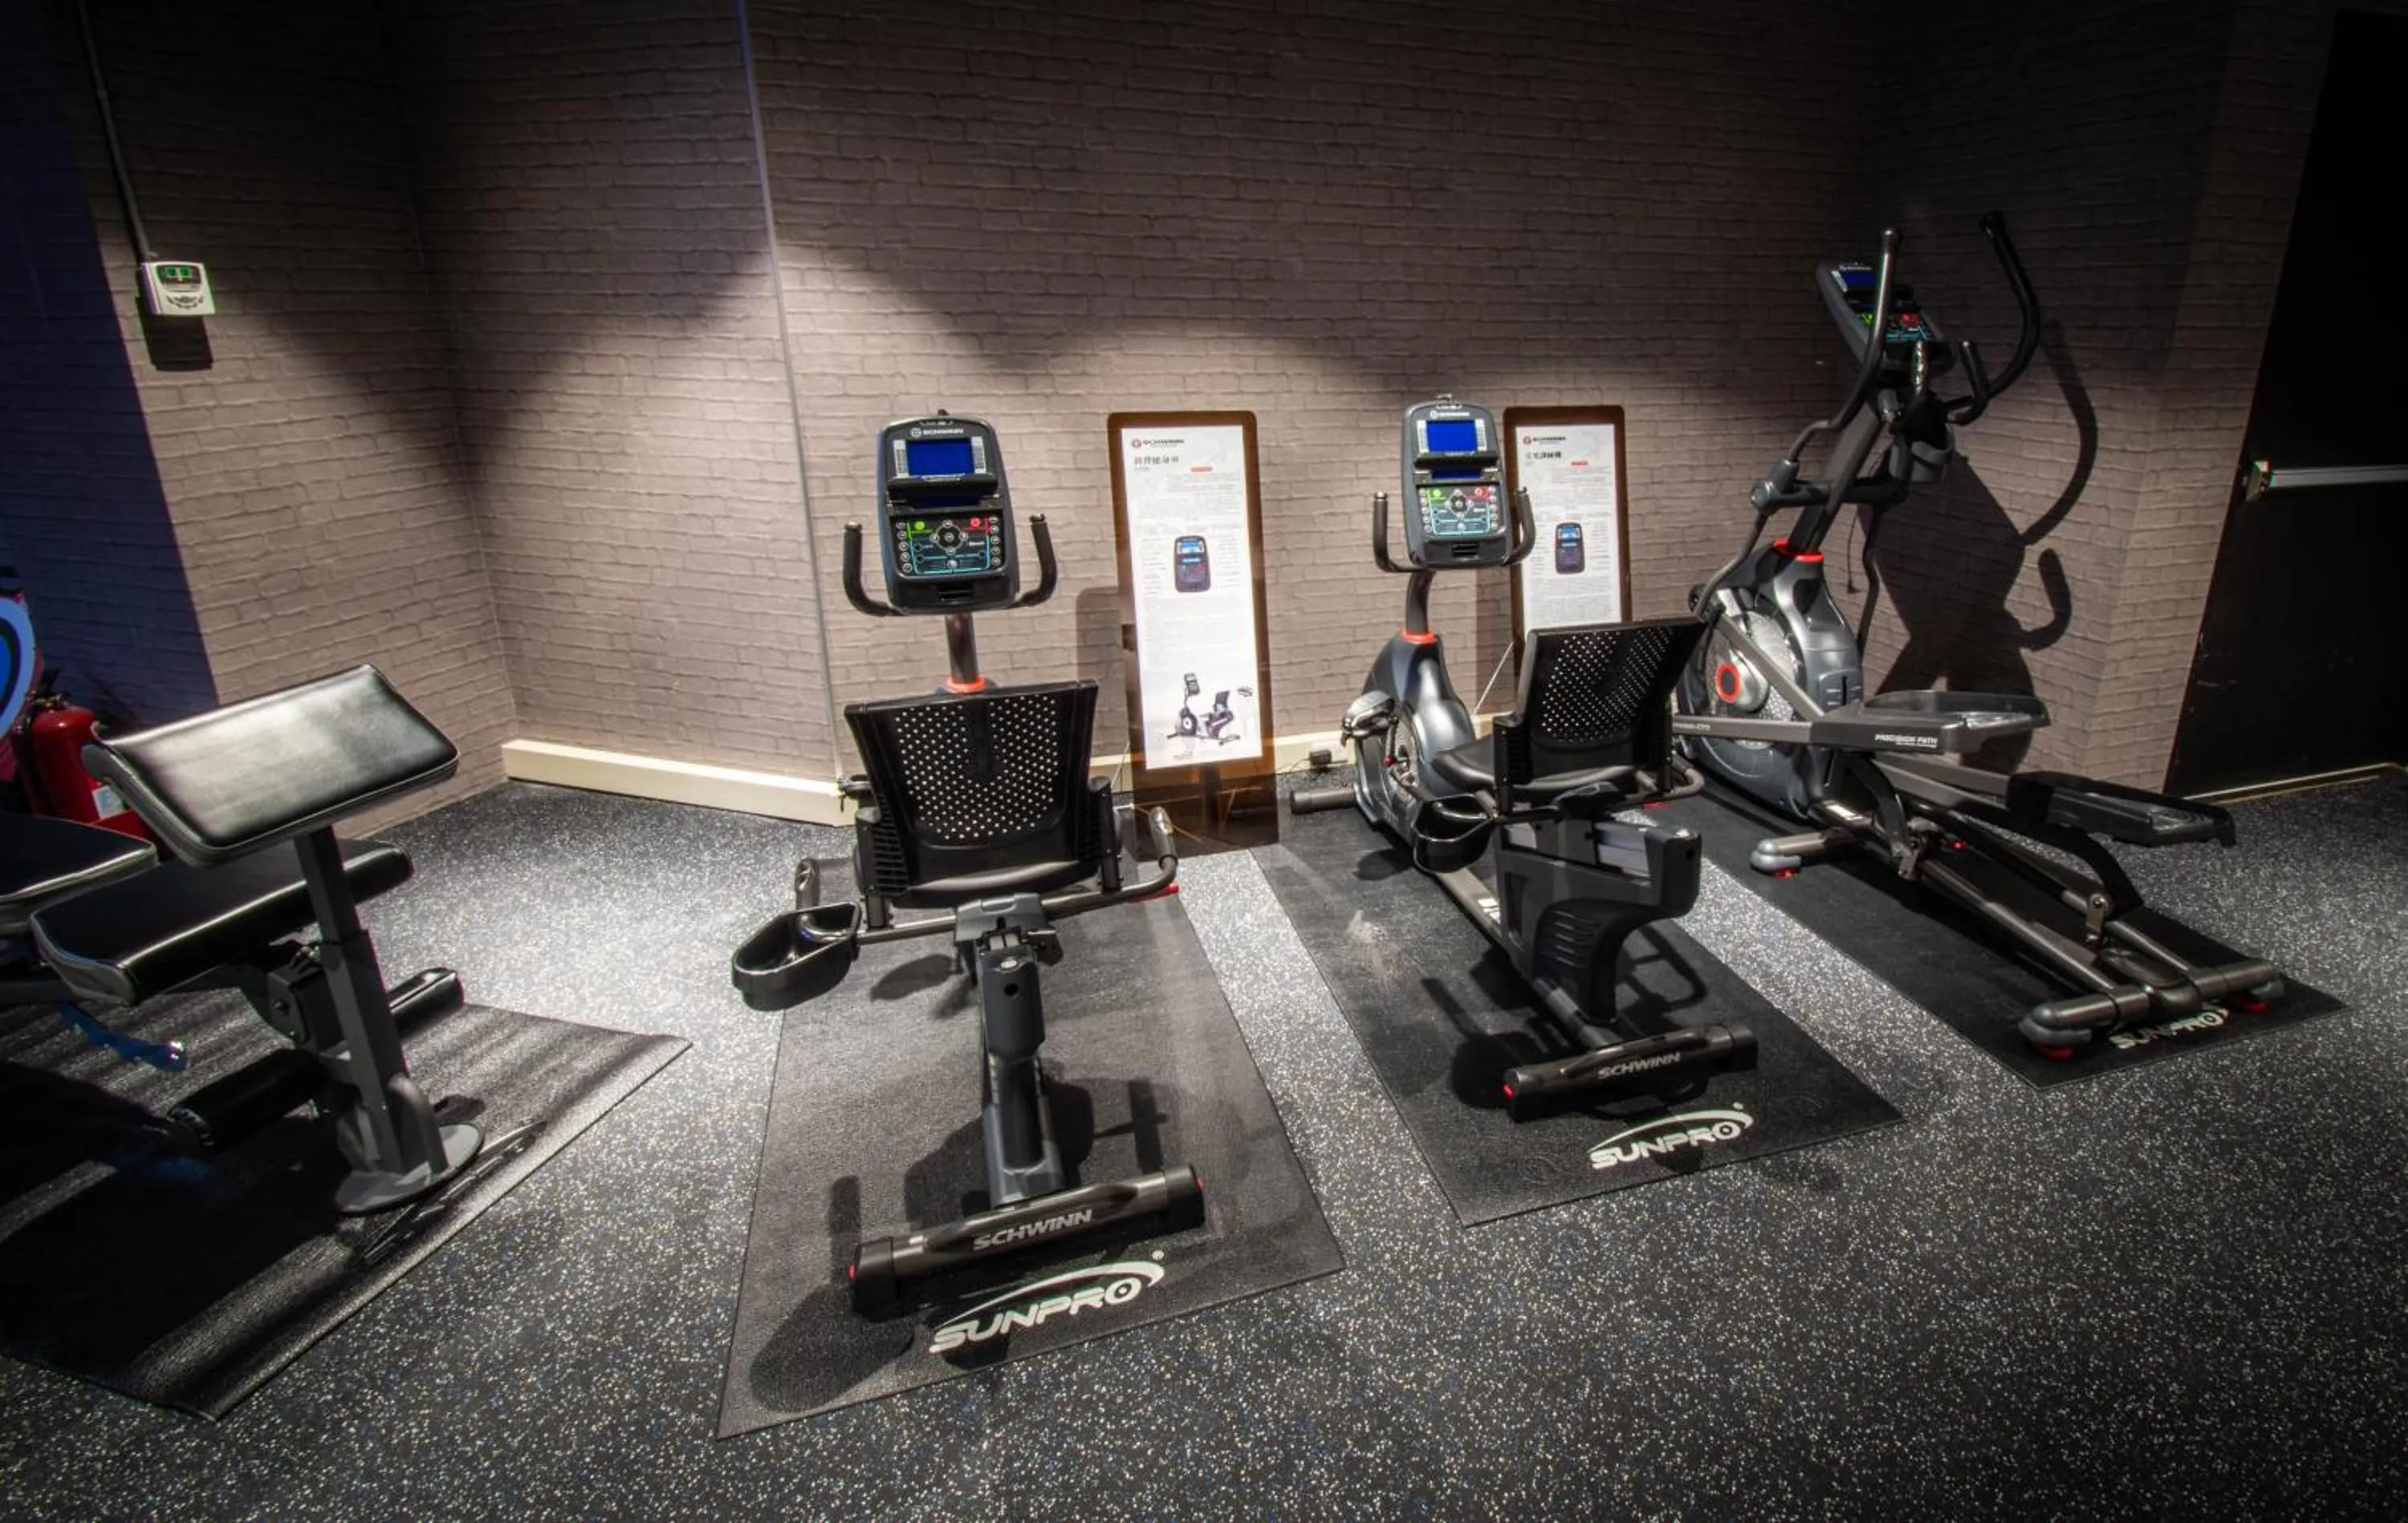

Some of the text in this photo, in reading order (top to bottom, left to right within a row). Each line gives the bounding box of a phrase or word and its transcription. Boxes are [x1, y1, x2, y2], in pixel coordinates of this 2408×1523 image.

[1598, 1052, 1682, 1080] SCHWINN
[1588, 1120, 1742, 1171] SUNPRO
[973, 1208, 1093, 1252] SCHWINN
[929, 1276, 1143, 1354] SUNPRO
